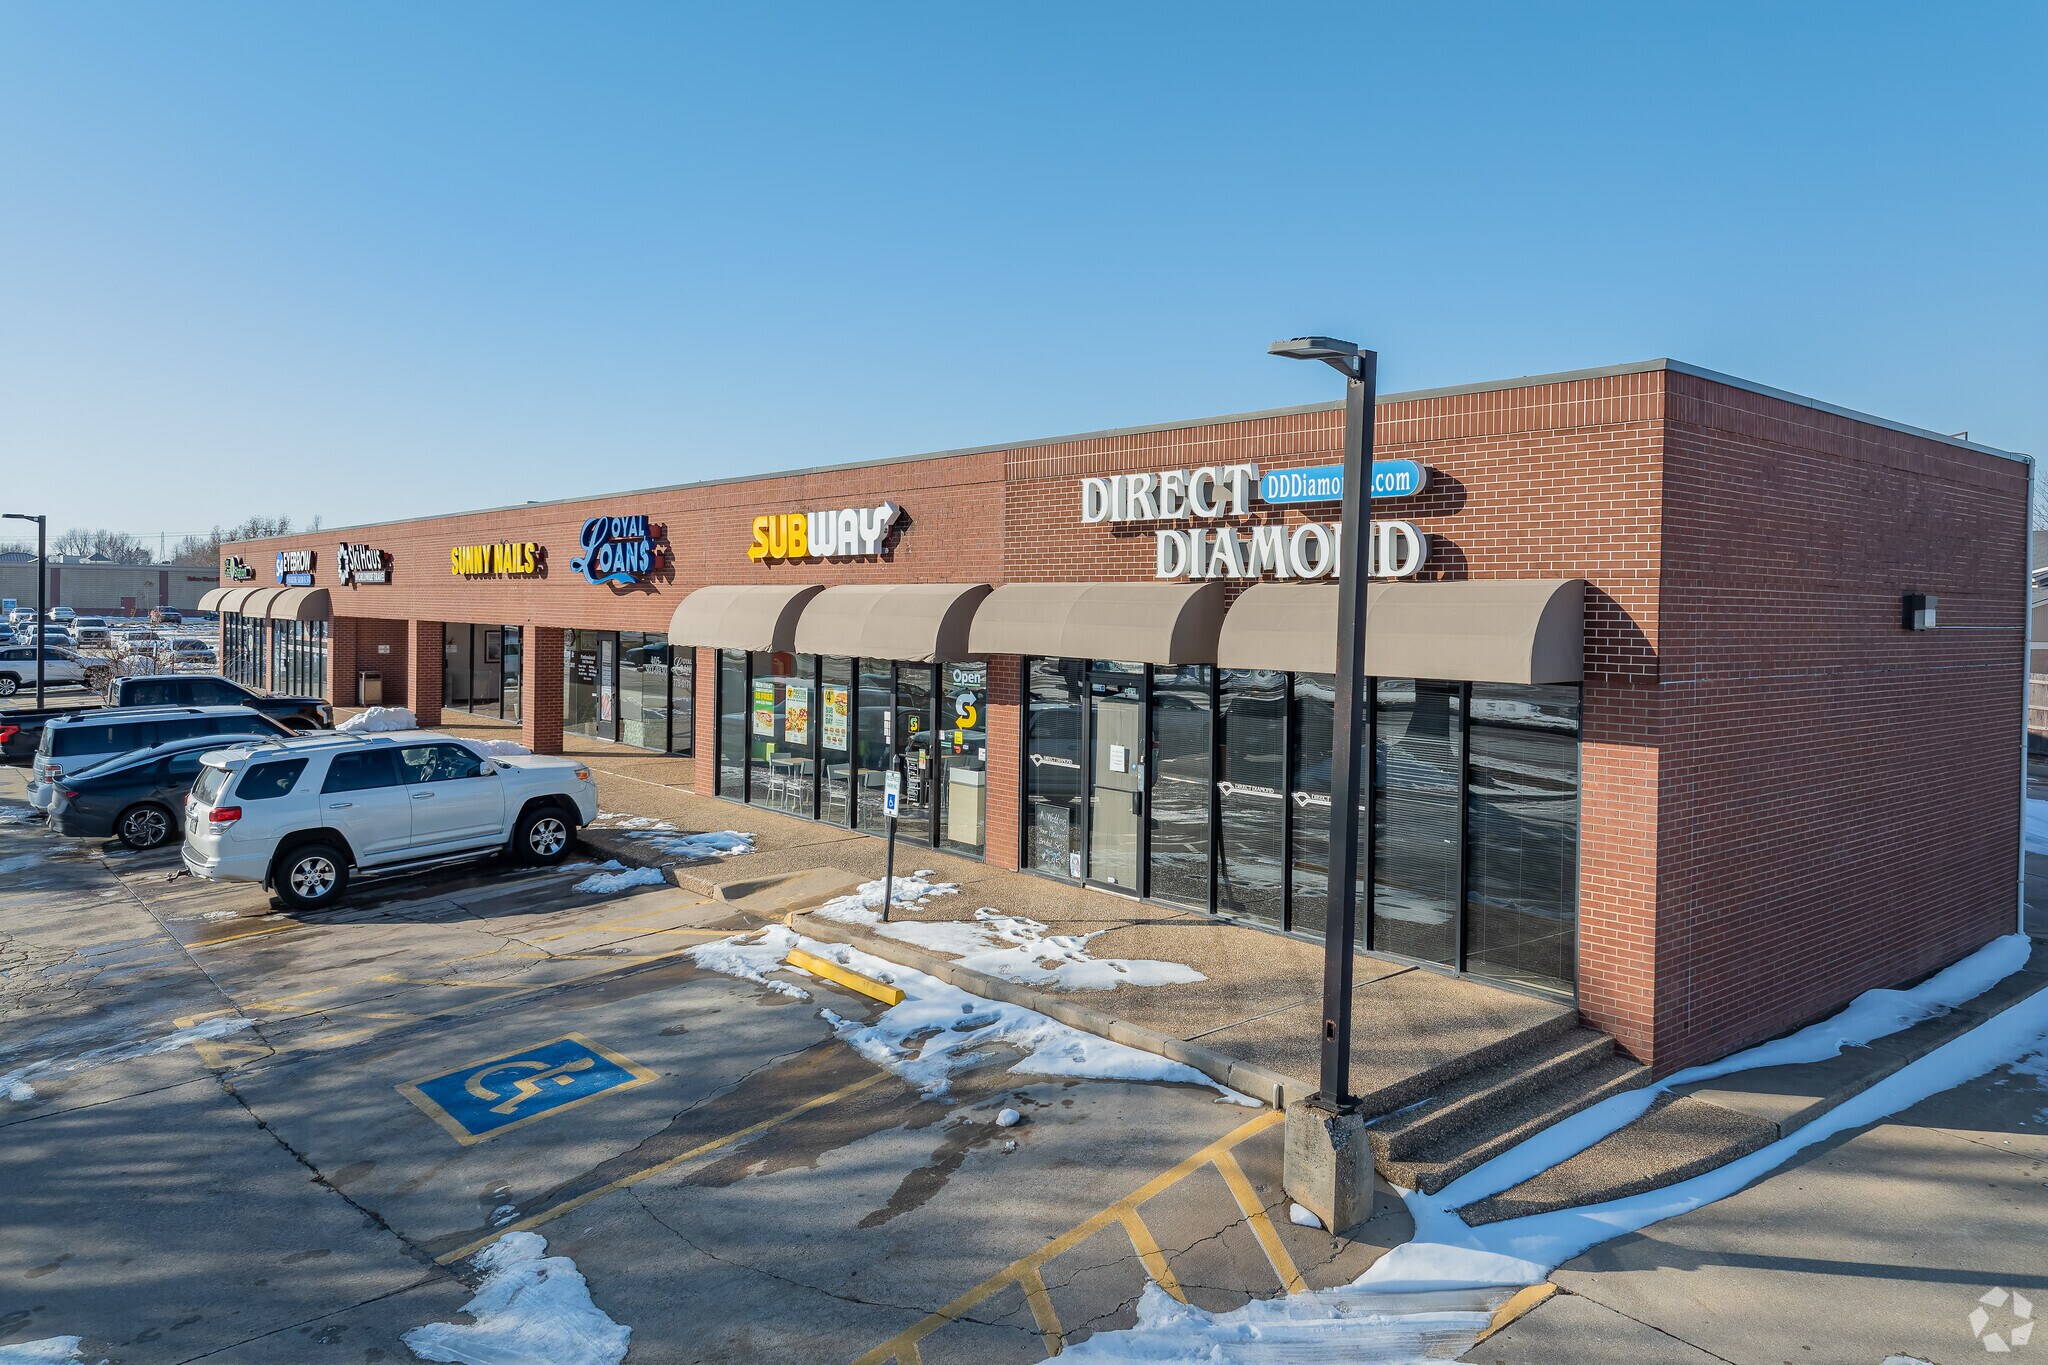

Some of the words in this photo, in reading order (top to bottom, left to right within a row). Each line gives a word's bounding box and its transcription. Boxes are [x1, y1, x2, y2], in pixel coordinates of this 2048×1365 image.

[1081, 463, 1255, 523] DIRECT
[1267, 470, 1411, 499] DDDiamo.com
[747, 501, 893, 563] SUBWAY
[284, 550, 311, 571] EYEBROW
[451, 545, 491, 576] SUNNY
[494, 541, 535, 574] NAILS
[952, 668, 981, 685] Open
[761, 692, 773, 701] FREE
[1235, 783, 1252, 791] DIRECT
[1252, 785, 1275, 794] DIAMOND
[1311, 793, 1331, 802] DIRECT
